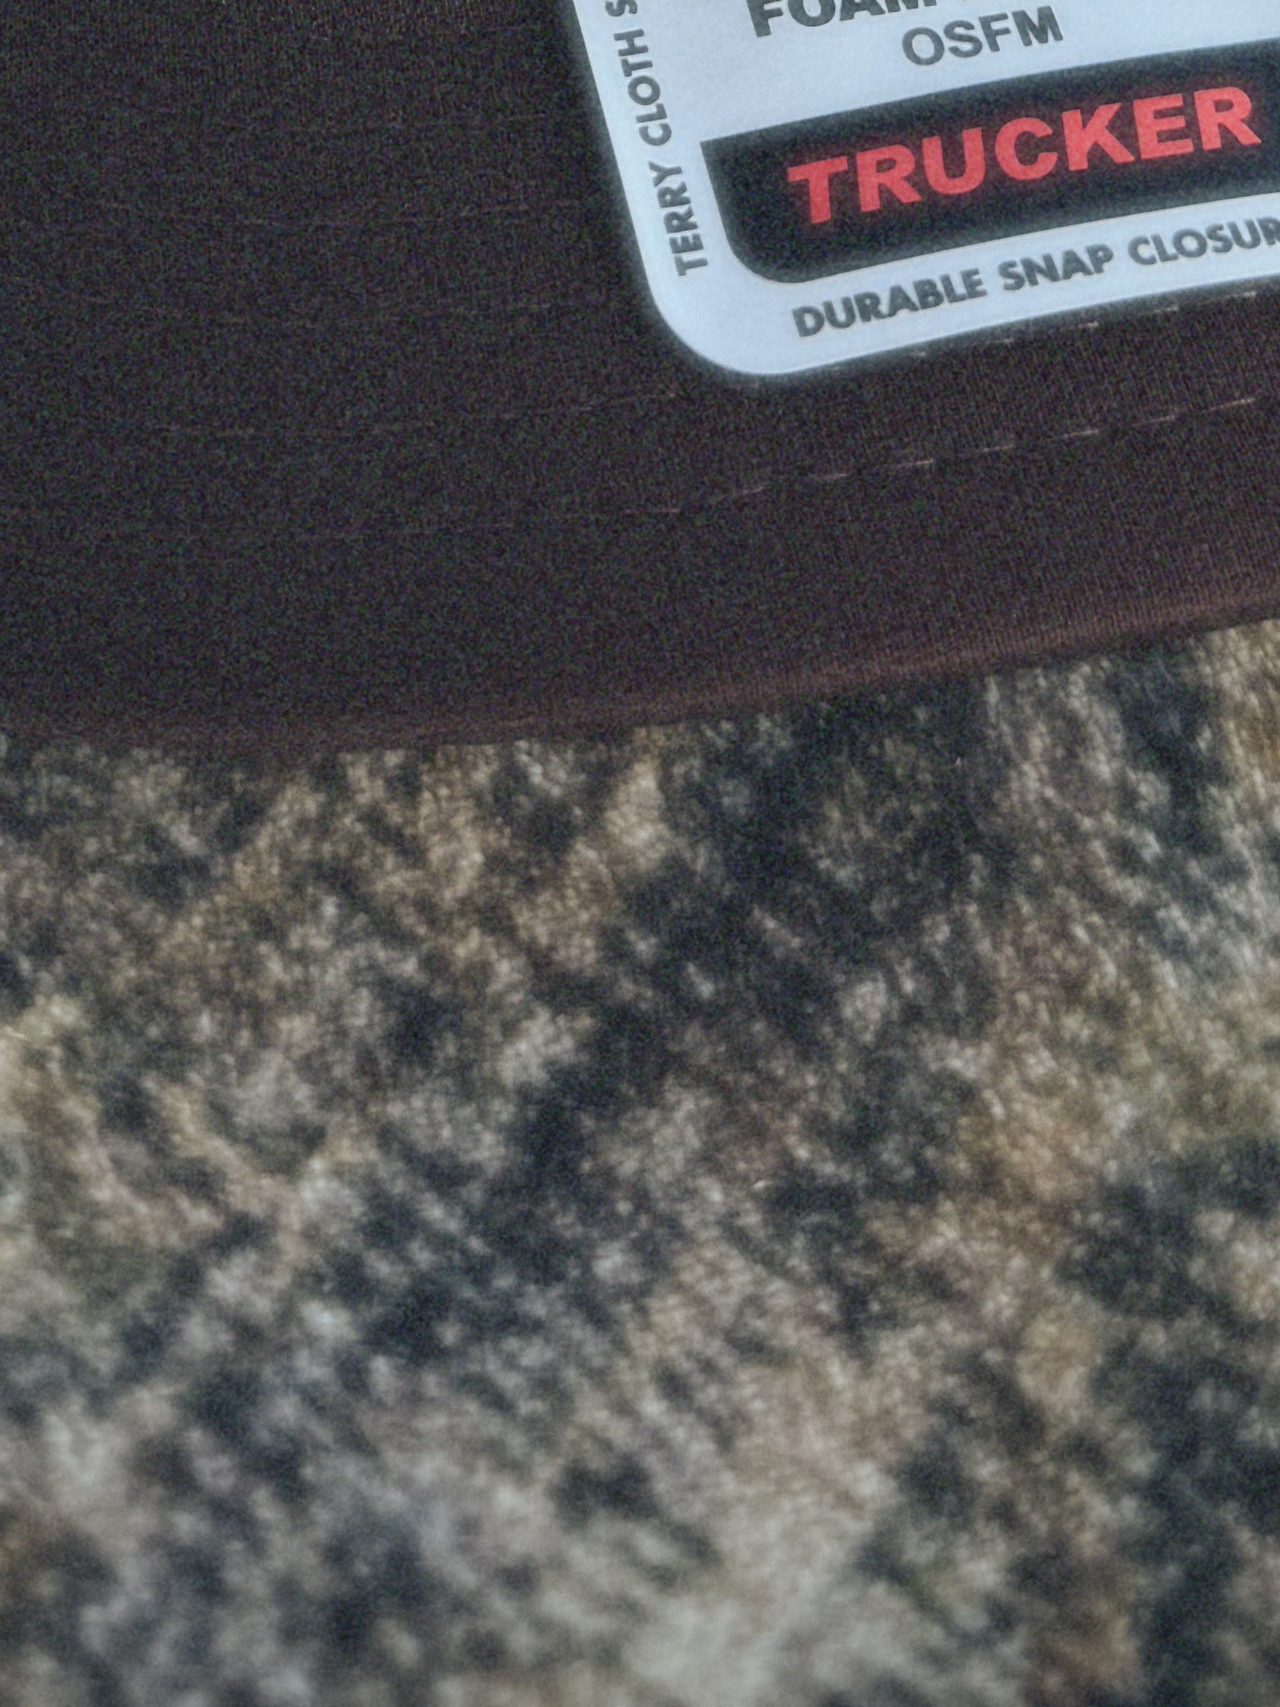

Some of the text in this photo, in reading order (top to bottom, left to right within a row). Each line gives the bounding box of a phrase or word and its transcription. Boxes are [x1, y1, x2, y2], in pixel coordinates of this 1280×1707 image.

[613, 28, 673, 147] CLOTH
[901, 5, 1064, 67] OSFM
[785, 85, 1262, 226] TRUCKER
[649, 162, 709, 277] TERRY
[791, 268, 988, 339] DURABLE
[998, 244, 1115, 292] SNAP
